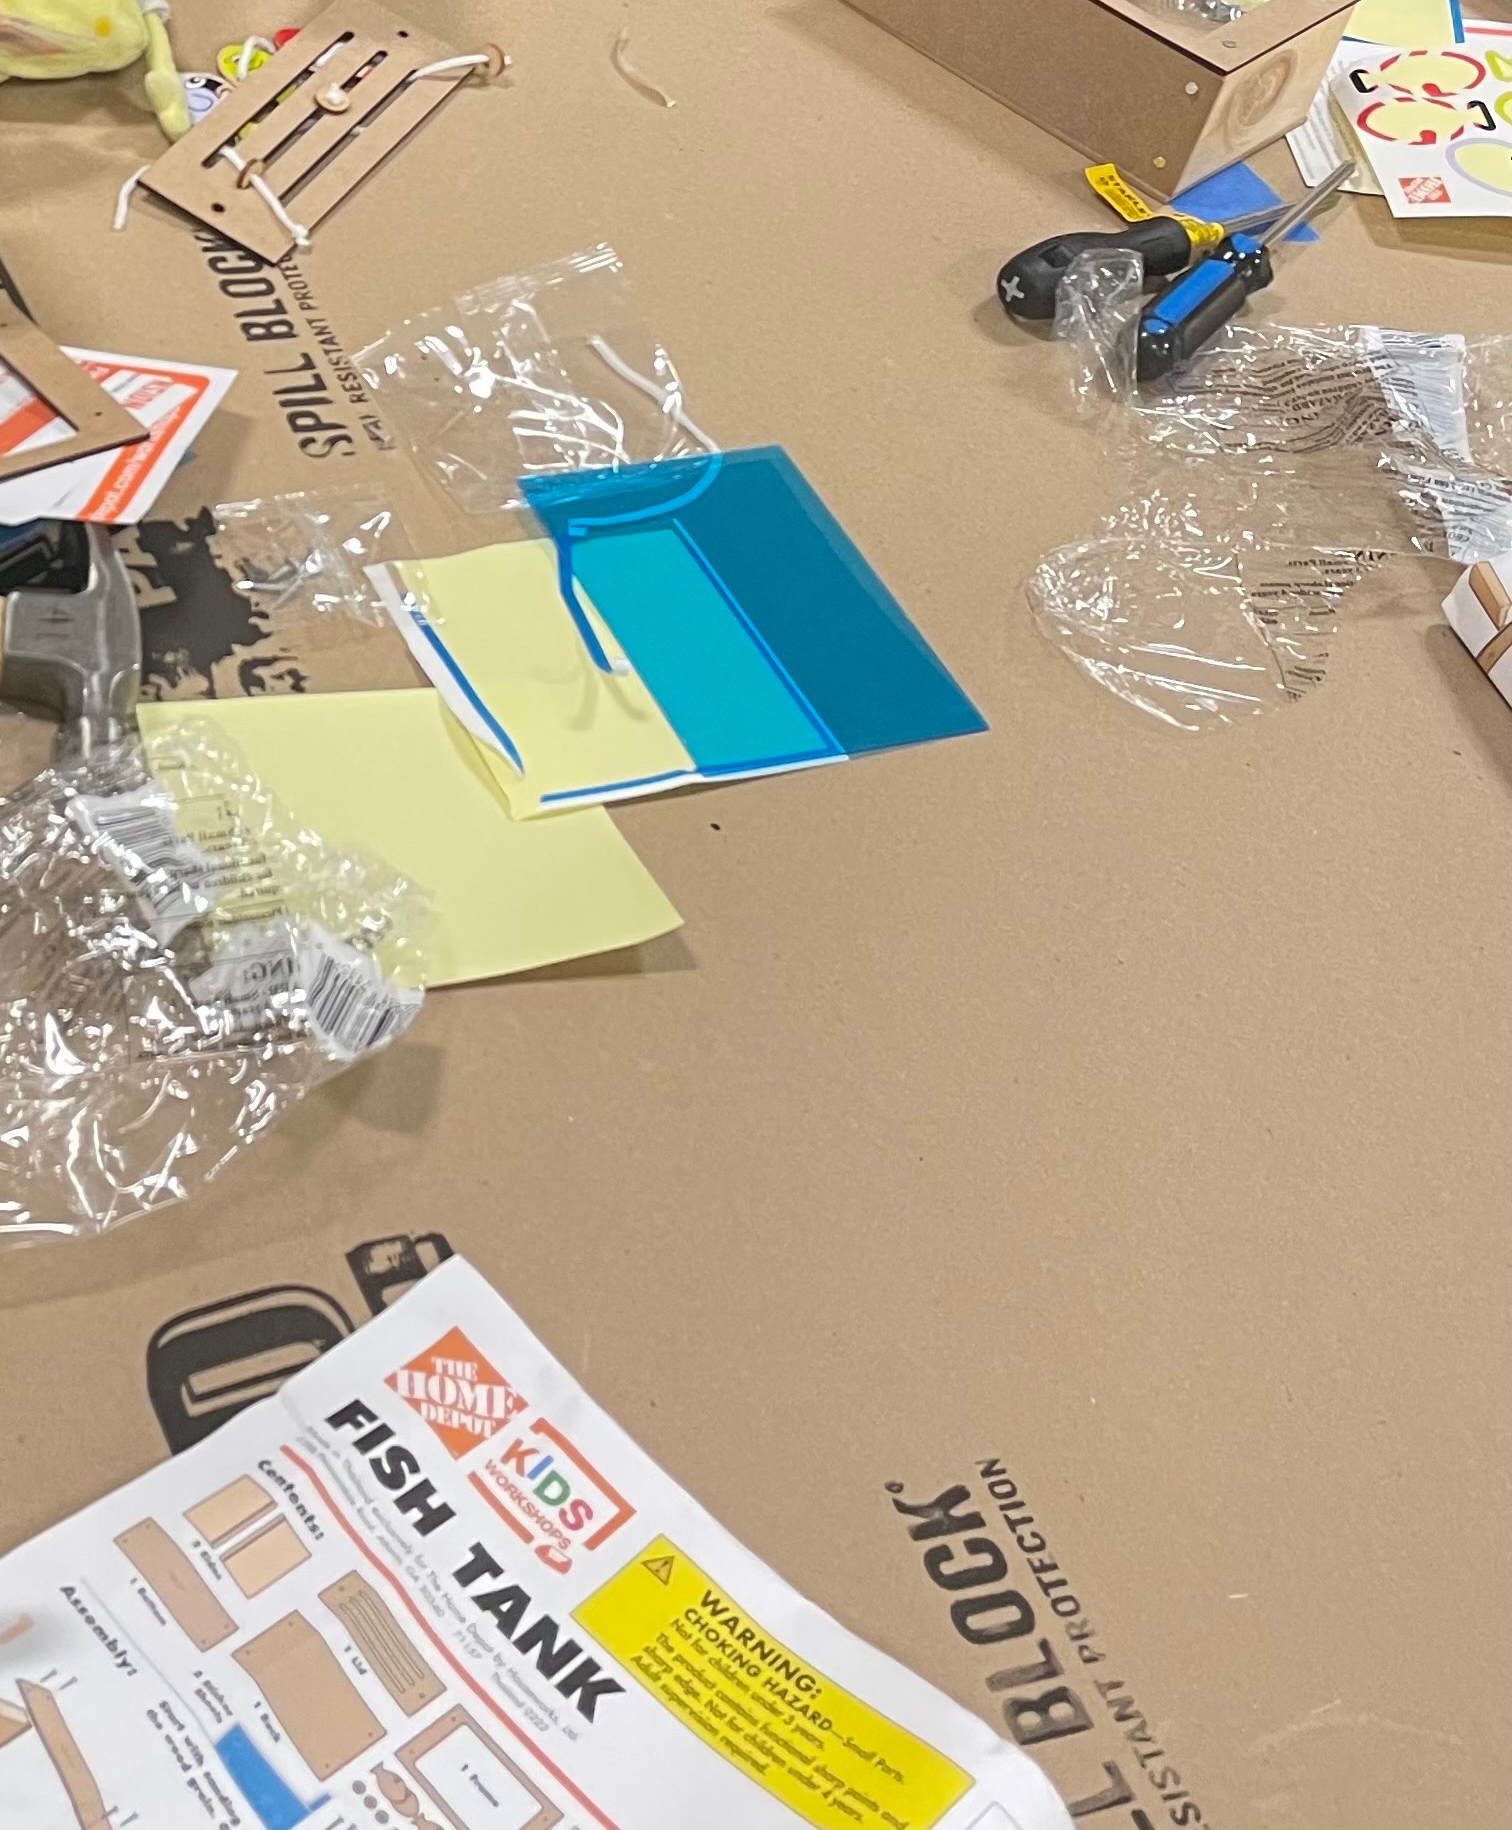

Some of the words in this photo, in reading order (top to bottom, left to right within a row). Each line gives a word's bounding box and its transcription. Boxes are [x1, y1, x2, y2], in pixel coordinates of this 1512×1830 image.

[1105, 171, 1149, 217] STANLE
[264, 352, 356, 459] SPILL
[306, 318, 368, 404] RESISTANT
[394, 1368, 519, 1420] HOME
[430, 1356, 478, 1381] THE
[418, 1402, 497, 1439] DEPOT
[256, 1459, 325, 1541] Contents:
[484, 1458, 573, 1552] WORKSHOPS
[499, 1438, 594, 1532] KIDS
[324, 1397, 457, 1537] FISH
[451, 1541, 627, 1724] TANK
[424, 1570, 445, 1592] The
[439, 1591, 471, 1625] Home
[975, 1458, 1106, 1665] PROTECTION
[59, 1584, 138, 1677] Assembly:
[699, 1589, 824, 1701] WARNING:
[892, 1484, 1095, 1746] BLOCK
[629, 1655, 661, 1683] Adult
[659, 1678, 721, 1737] supervision
[655, 1631, 676, 1653] The
[671, 1649, 716, 1689] product
[879, 1808, 910, 1830] and
[670, 1617, 693, 1642] Not
[691, 1633, 709, 1655] for
[708, 1654, 751, 1690] children
[750, 1689, 786, 1718] under
[794, 1724, 826, 1751] years.
[683, 1606, 762, 1679] CHOKING
[875, 1758, 906, 1785] Parts.
[642, 1644, 674, 1675] sharp
[703, 1699, 727, 1724] Not
[725, 1716, 744, 1736] for
[743, 1730, 788, 1769] children
[787, 1765, 821, 1793] under
[831, 1796, 864, 1825] years.
[1094, 1680, 1210, 1830] SISTANT
